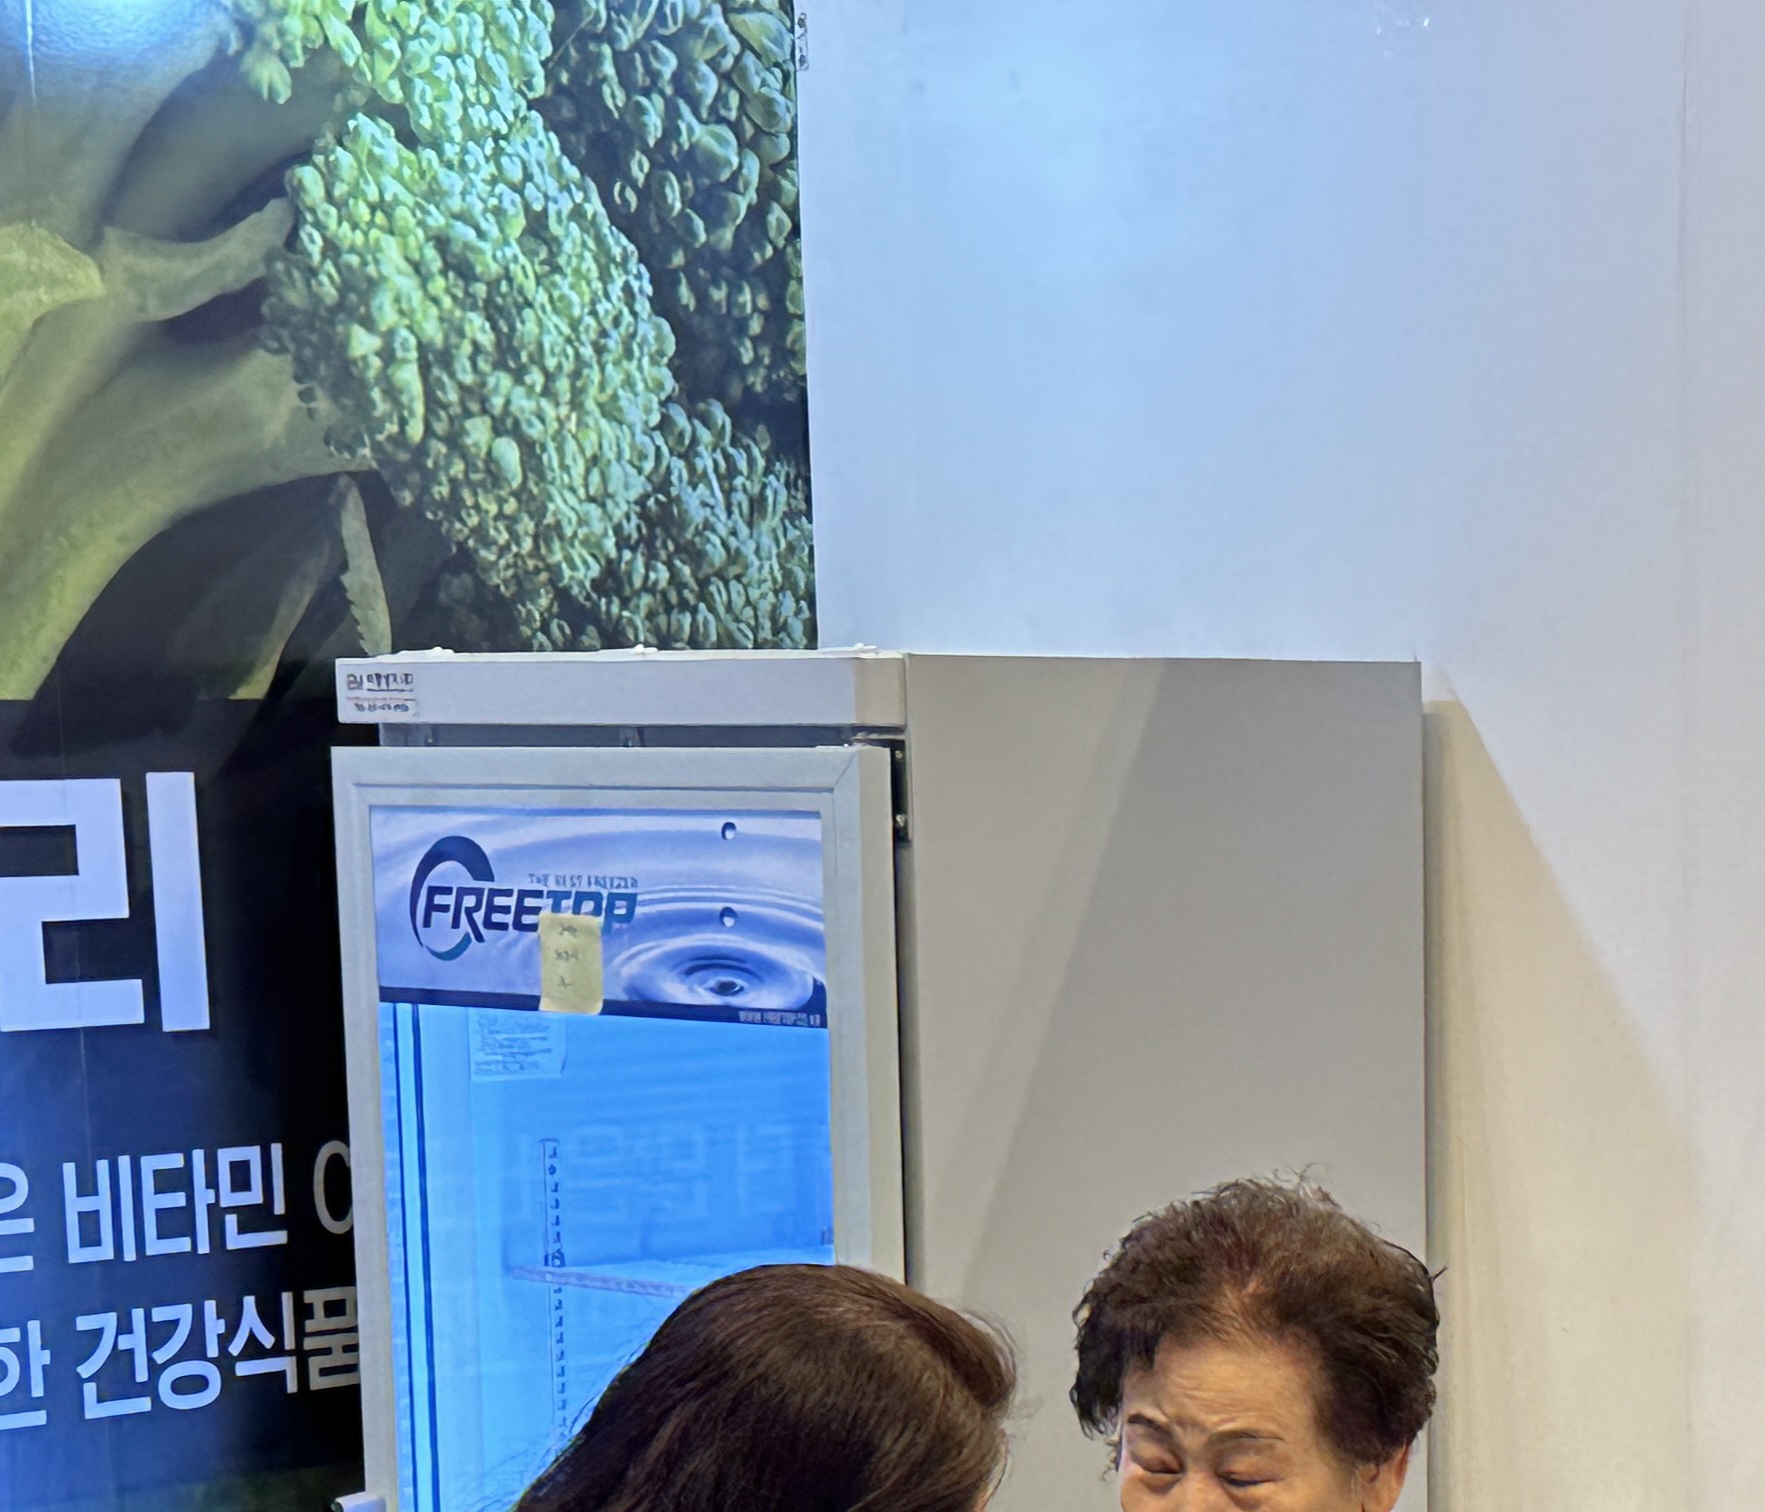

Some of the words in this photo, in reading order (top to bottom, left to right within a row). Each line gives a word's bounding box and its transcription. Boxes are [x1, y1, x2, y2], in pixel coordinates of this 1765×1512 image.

[0, 771, 210, 1032] 리
[63, 1143, 288, 1264] 비타민
[76, 1286, 360, 1420] 건강식품
